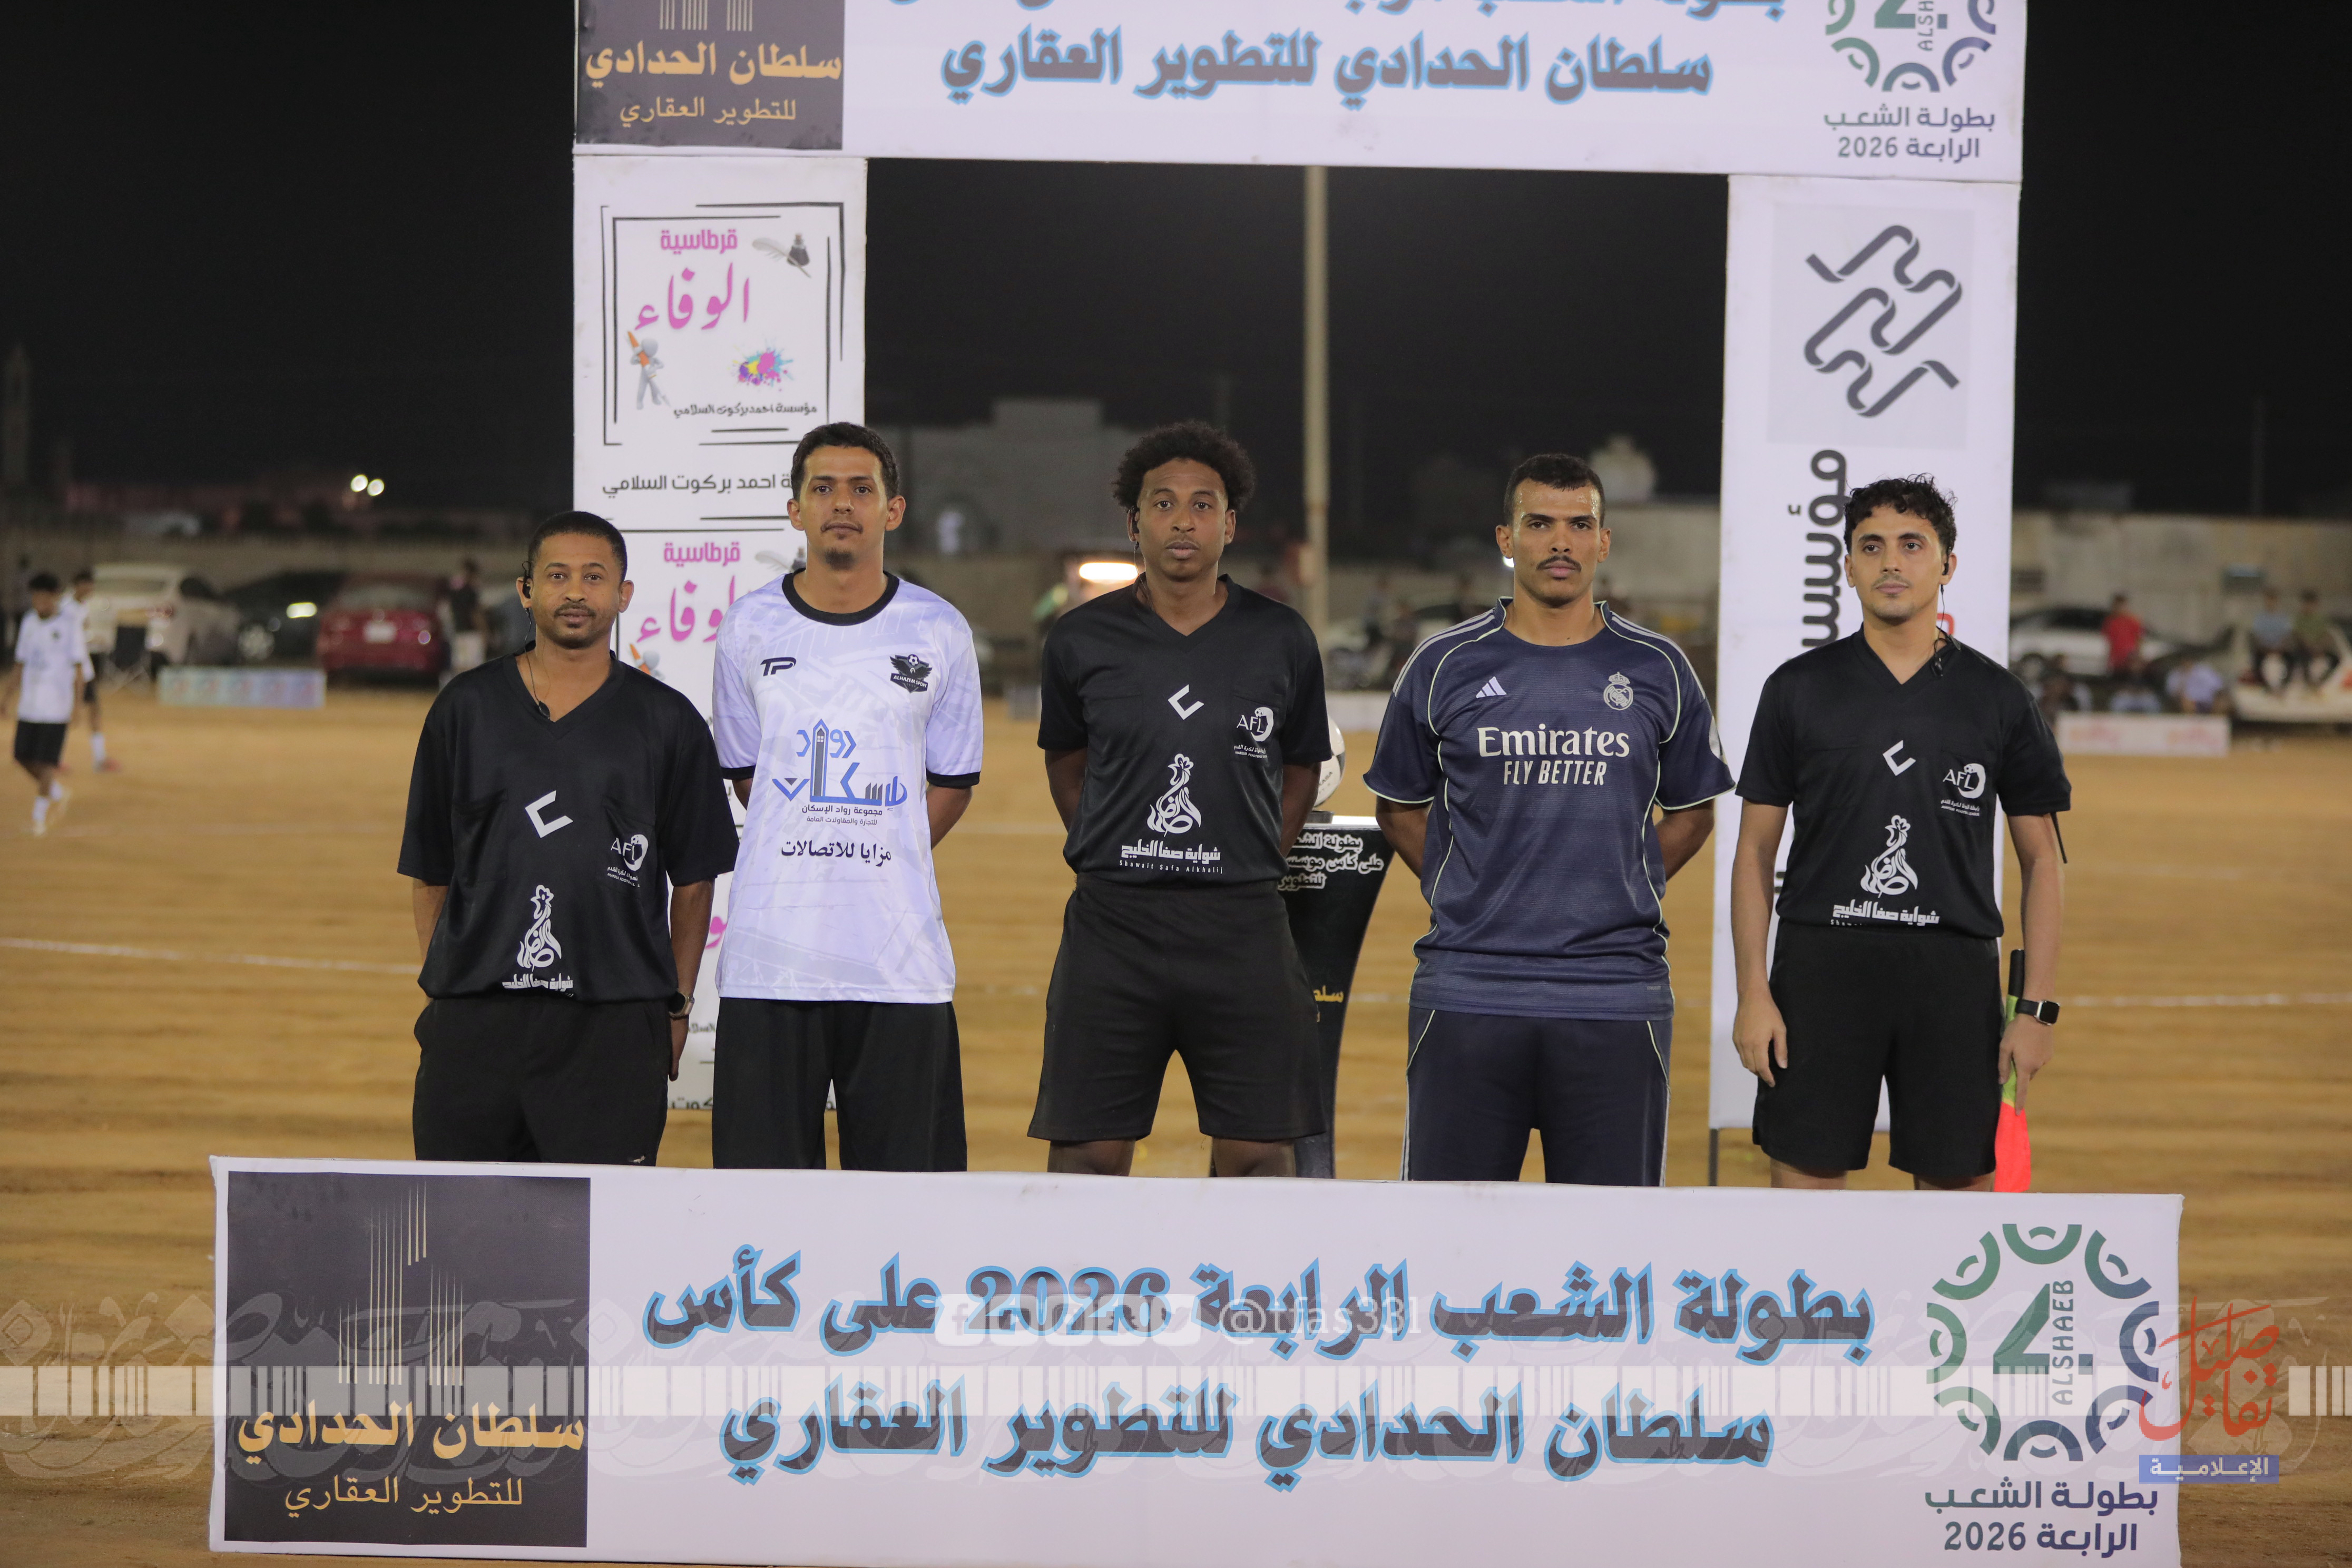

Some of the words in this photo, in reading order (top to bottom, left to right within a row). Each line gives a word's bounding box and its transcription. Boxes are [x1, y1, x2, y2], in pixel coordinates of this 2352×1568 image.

[585, 41, 717, 89] الحدادي
[730, 43, 842, 85] سلطان
[940, 25, 1122, 104] العقاري
[1134, 27, 1321, 100] للتطوير
[1333, 34, 1530, 110] الحدادي
[1544, 33, 1713, 104] سلطان
[619, 96, 705, 128] العقاري
[717, 99, 797, 125] للتطوير
[1824, 103, 1909, 131] الشعب
[1917, 107, 1996, 133] بطولة
[1838, 136, 1898, 159] 2026
[1906, 137, 1980, 164] الرابعة
[660, 229, 738, 255] قرطاسية
[634, 262, 751, 330] الوفاء
[673, 404, 715, 418] السلامي
[602, 475, 667, 498] السلامي
[736, 474, 776, 489] احمد
[663, 542, 741, 567] قرطاسية
[893, 675, 915, 684] ALHAZEM
[916, 680, 927, 689] SPORT
[1236, 714, 1265, 733] AFL
[1477, 723, 1630, 757] Emirates
[1503, 760, 1534, 785] FLY
[1538, 760, 1607, 786] BETTER
[1943, 769, 1974, 790] AFL
[802, 804, 833, 815] الإسكان
[836, 805, 851, 815] رواد
[854, 807, 883, 817] مجموعة
[781, 840, 855, 859] للاتصالات
[860, 842, 892, 867] مزايا
[1121, 838, 1159, 859] الخليج
[1158, 840, 1183, 860] صفا
[1185, 843, 1221, 865] شواية
[1324, 834, 1364, 854] بطولة
[1119, 860, 1154, 869] Shawait
[1186, 866, 1223, 875] Alkhalij
[1358, 852, 1385, 875] على
[1832, 899, 1873, 919] الخليج
[1871, 901, 1899, 921] صفا
[1899, 906, 1941, 927] شواية
[642, 1243, 802, 1345] كأس
[818, 1250, 946, 1358] على
[963, 1265, 1171, 1338] 2026
[1190, 1257, 1412, 1360] الرابعة
[1429, 1258, 1653, 1364] الشعب
[1673, 1267, 1876, 1367] بطولة
[2052, 1280, 2074, 1405] ALSHAEB
[238, 1399, 416, 1466] الحدادي
[432, 1400, 584, 1459] سلطان
[719, 1372, 968, 1486] العقاري
[980, 1378, 1242, 1480] للتطوير
[1255, 1380, 1524, 1493] الحدادي
[1544, 1380, 1775, 1482] سلطان
[285, 1475, 399, 1518] العقاري
[411, 1476, 523, 1514] للتطوير
[1924, 1476, 2042, 1515] الشعب
[2050, 1481, 2158, 1517] بطولة
[1944, 1521, 2026, 1552] 2026
[2036, 1523, 2138, 1559] الرابعة
